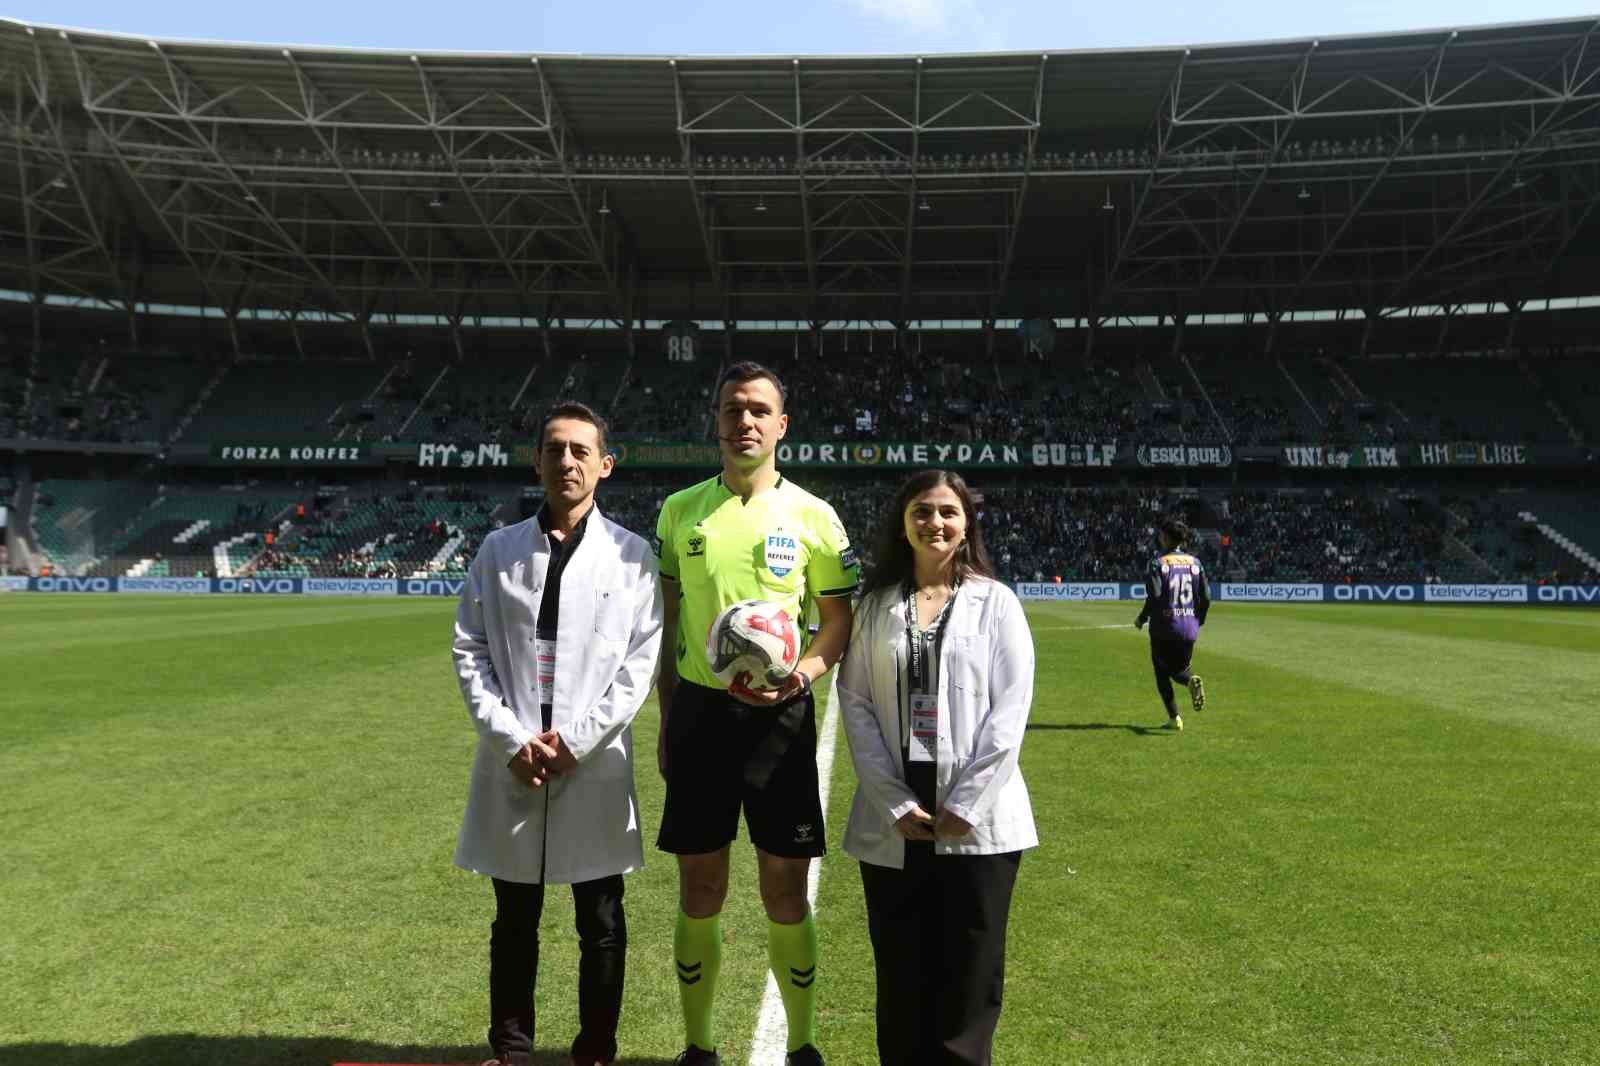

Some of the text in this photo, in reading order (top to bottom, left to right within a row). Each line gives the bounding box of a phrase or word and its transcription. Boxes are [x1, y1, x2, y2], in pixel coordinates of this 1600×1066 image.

[221, 447, 281, 460] FORZA
[777, 444, 1019, 463] ODRI MEYDAN
[1187, 447, 1221, 464] RUH
[768, 535, 796, 549] FIFA
[767, 552, 795, 562] REFEREE
[36, 576, 110, 591] onvo
[219, 577, 294, 593] onvo
[306, 580, 394, 594] televizyon
[407, 579, 465, 594] onv
[1021, 583, 1115, 598] televizyon
[1224, 584, 1320, 599] televizyon
[1333, 584, 1415, 601] onvo
[1429, 584, 1524, 600] televizyon
[1537, 585, 1600, 601] onv
